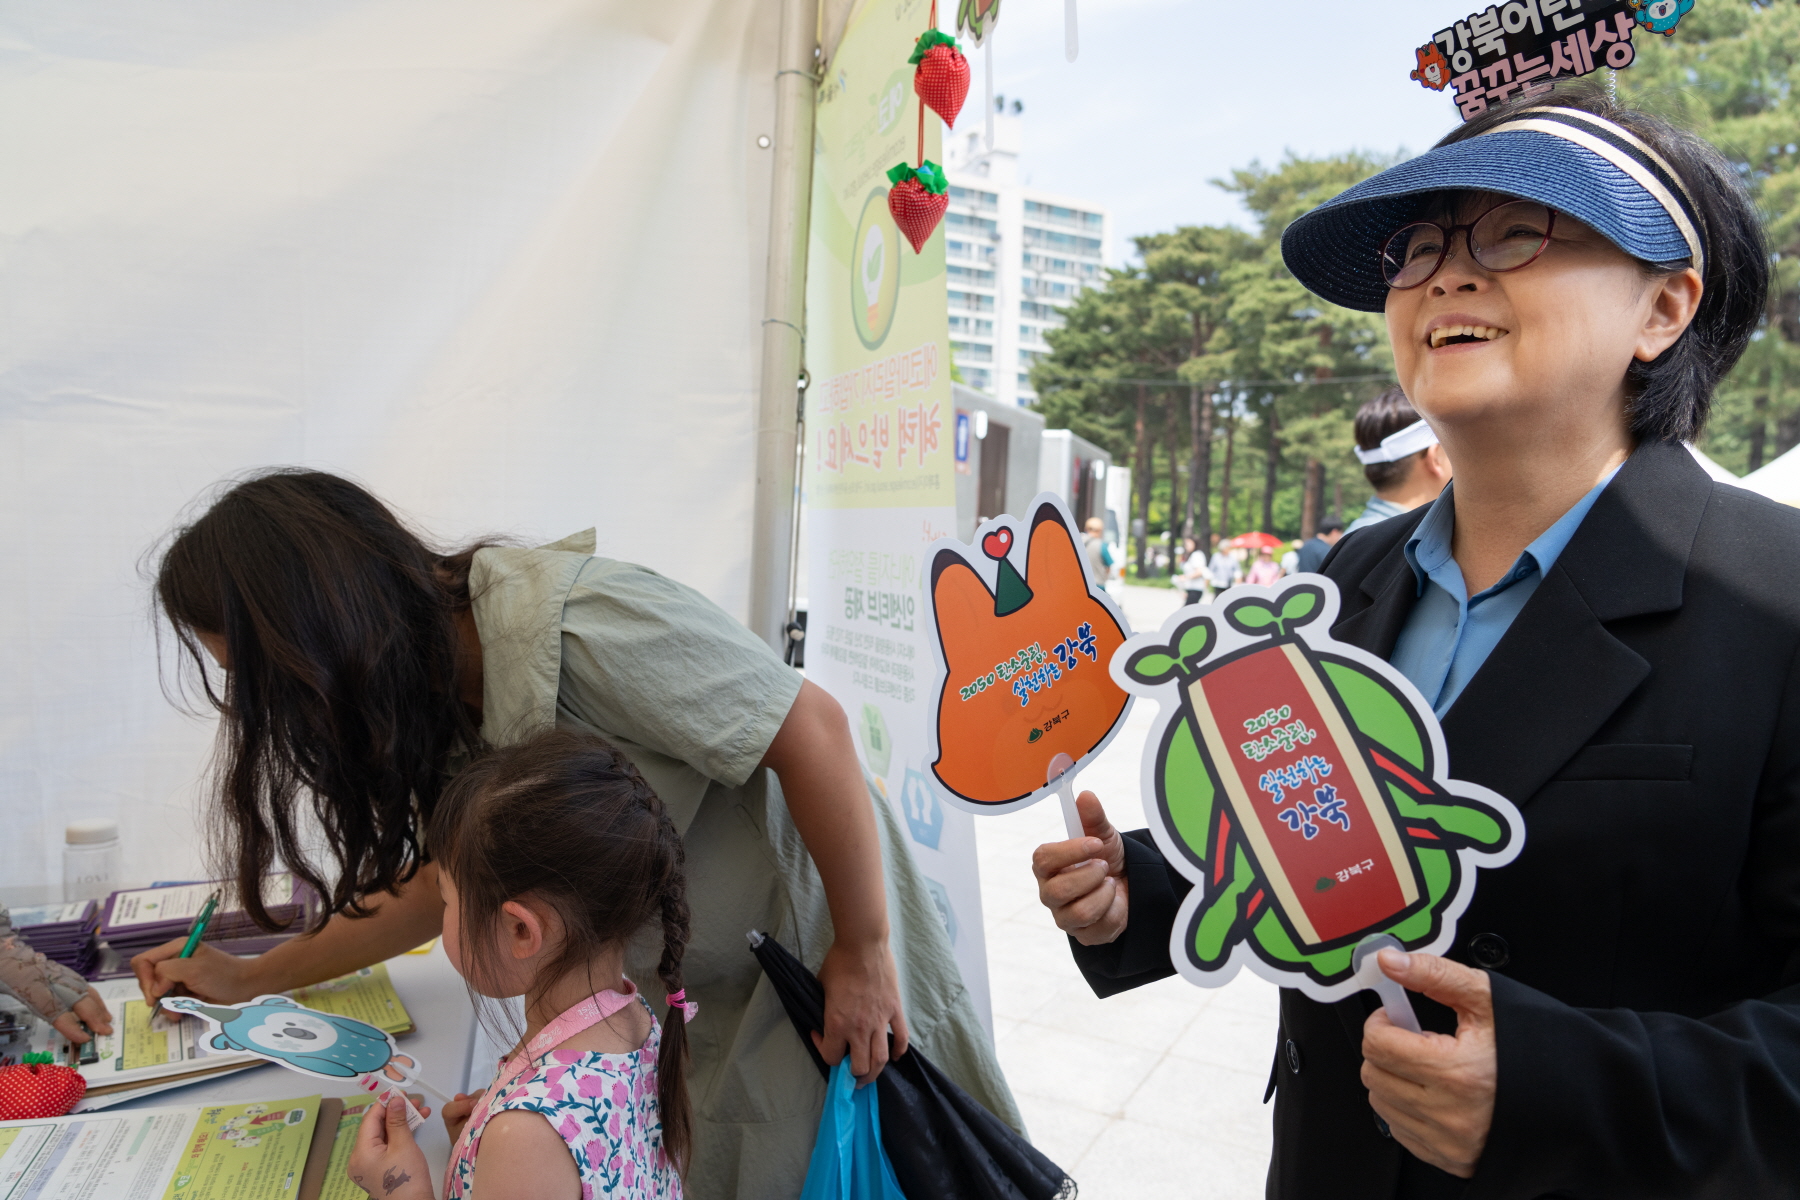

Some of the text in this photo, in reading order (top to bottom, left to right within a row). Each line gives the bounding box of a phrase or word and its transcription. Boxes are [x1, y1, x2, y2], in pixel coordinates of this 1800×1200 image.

[960, 642, 1047, 701] 2050 탄소중립,
[1013, 622, 1097, 707] 실천하는 강북
[1043, 709, 1070, 732] 강북구
[1241, 720, 1316, 762] 탄소중립,
[1244, 705, 1291, 735] 2050
[1259, 756, 1332, 804] 실천하는
[1278, 785, 1350, 840] 강북
[1335, 858, 1375, 883] 강북구
